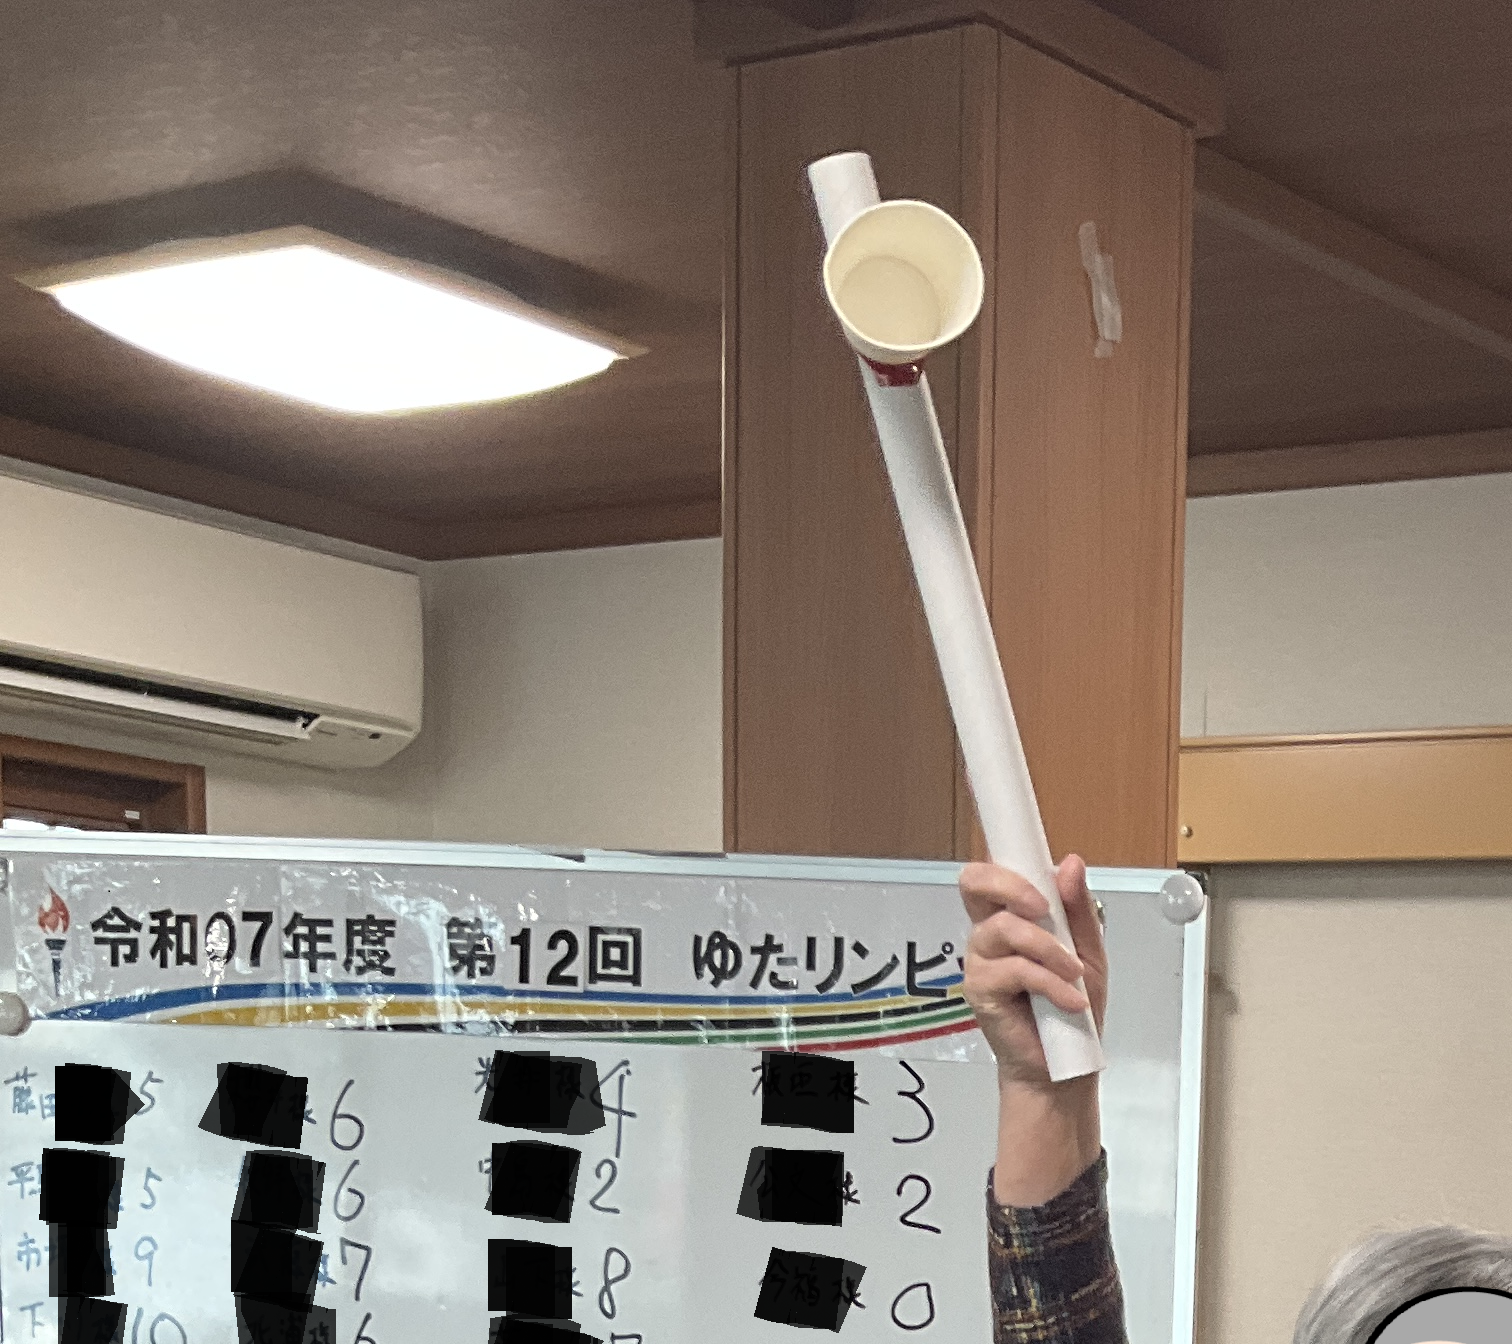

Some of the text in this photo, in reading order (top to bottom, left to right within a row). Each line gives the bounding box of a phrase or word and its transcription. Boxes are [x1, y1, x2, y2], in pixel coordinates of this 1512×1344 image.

[91, 906, 965, 998] 令和07年度 第12回 ゆたリンピ
[330, 1079, 364, 1151] 6
[590, 1060, 637, 1158] 4
[892, 1060, 934, 1143] 3
[140, 1167, 162, 1209] 5
[334, 1159, 365, 1222] 6
[590, 1159, 620, 1214] 2
[897, 1174, 941, 1234] 2
[134, 1235, 158, 1286] 9
[340, 1237, 372, 1302] 7
[599, 1247, 631, 1319] 8
[891, 1282, 935, 1330] 0
